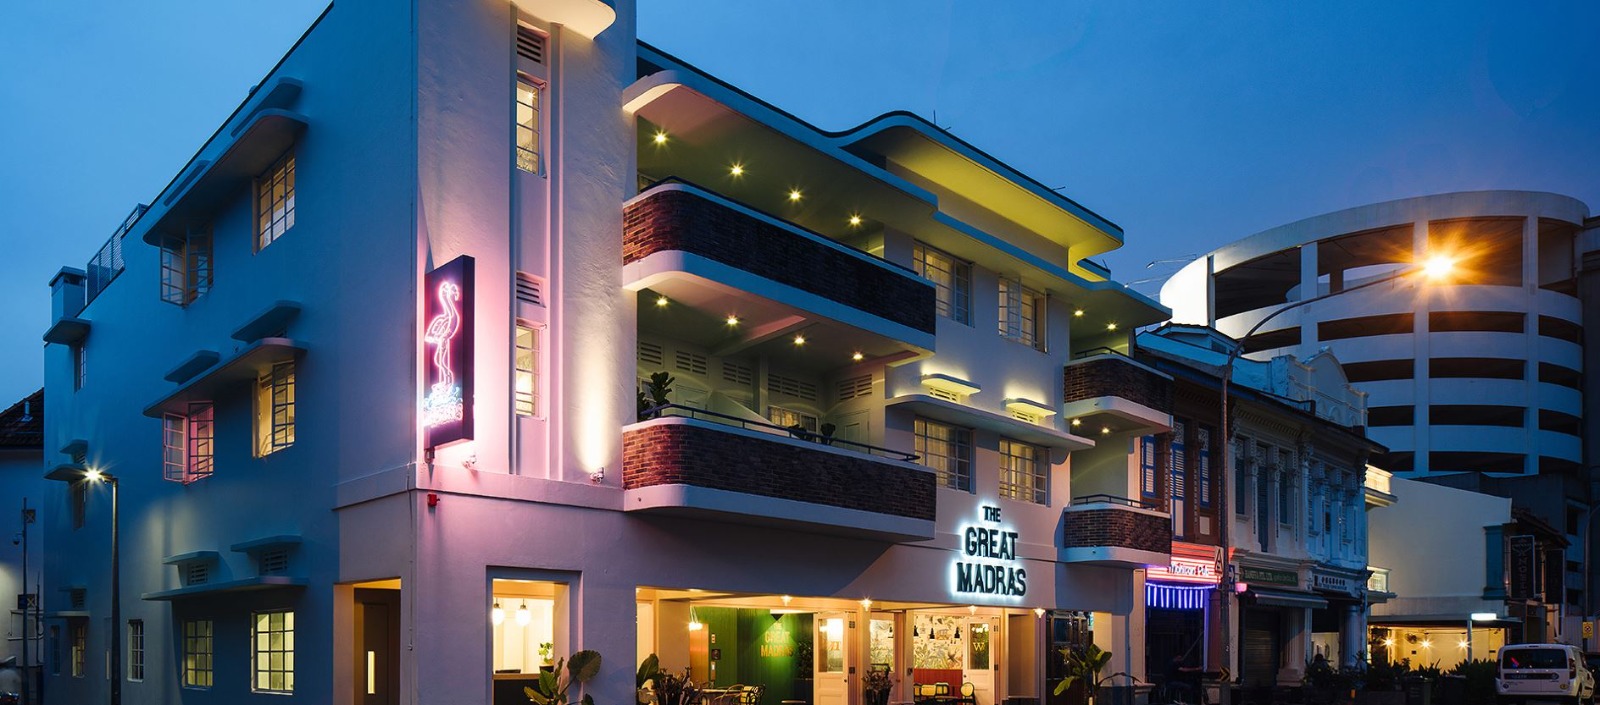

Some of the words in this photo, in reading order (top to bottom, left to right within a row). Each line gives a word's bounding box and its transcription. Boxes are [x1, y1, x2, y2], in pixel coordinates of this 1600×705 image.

[982, 505, 1001, 522] THE
[965, 526, 1018, 560] GREAT
[956, 562, 1026, 596] MADRAS
